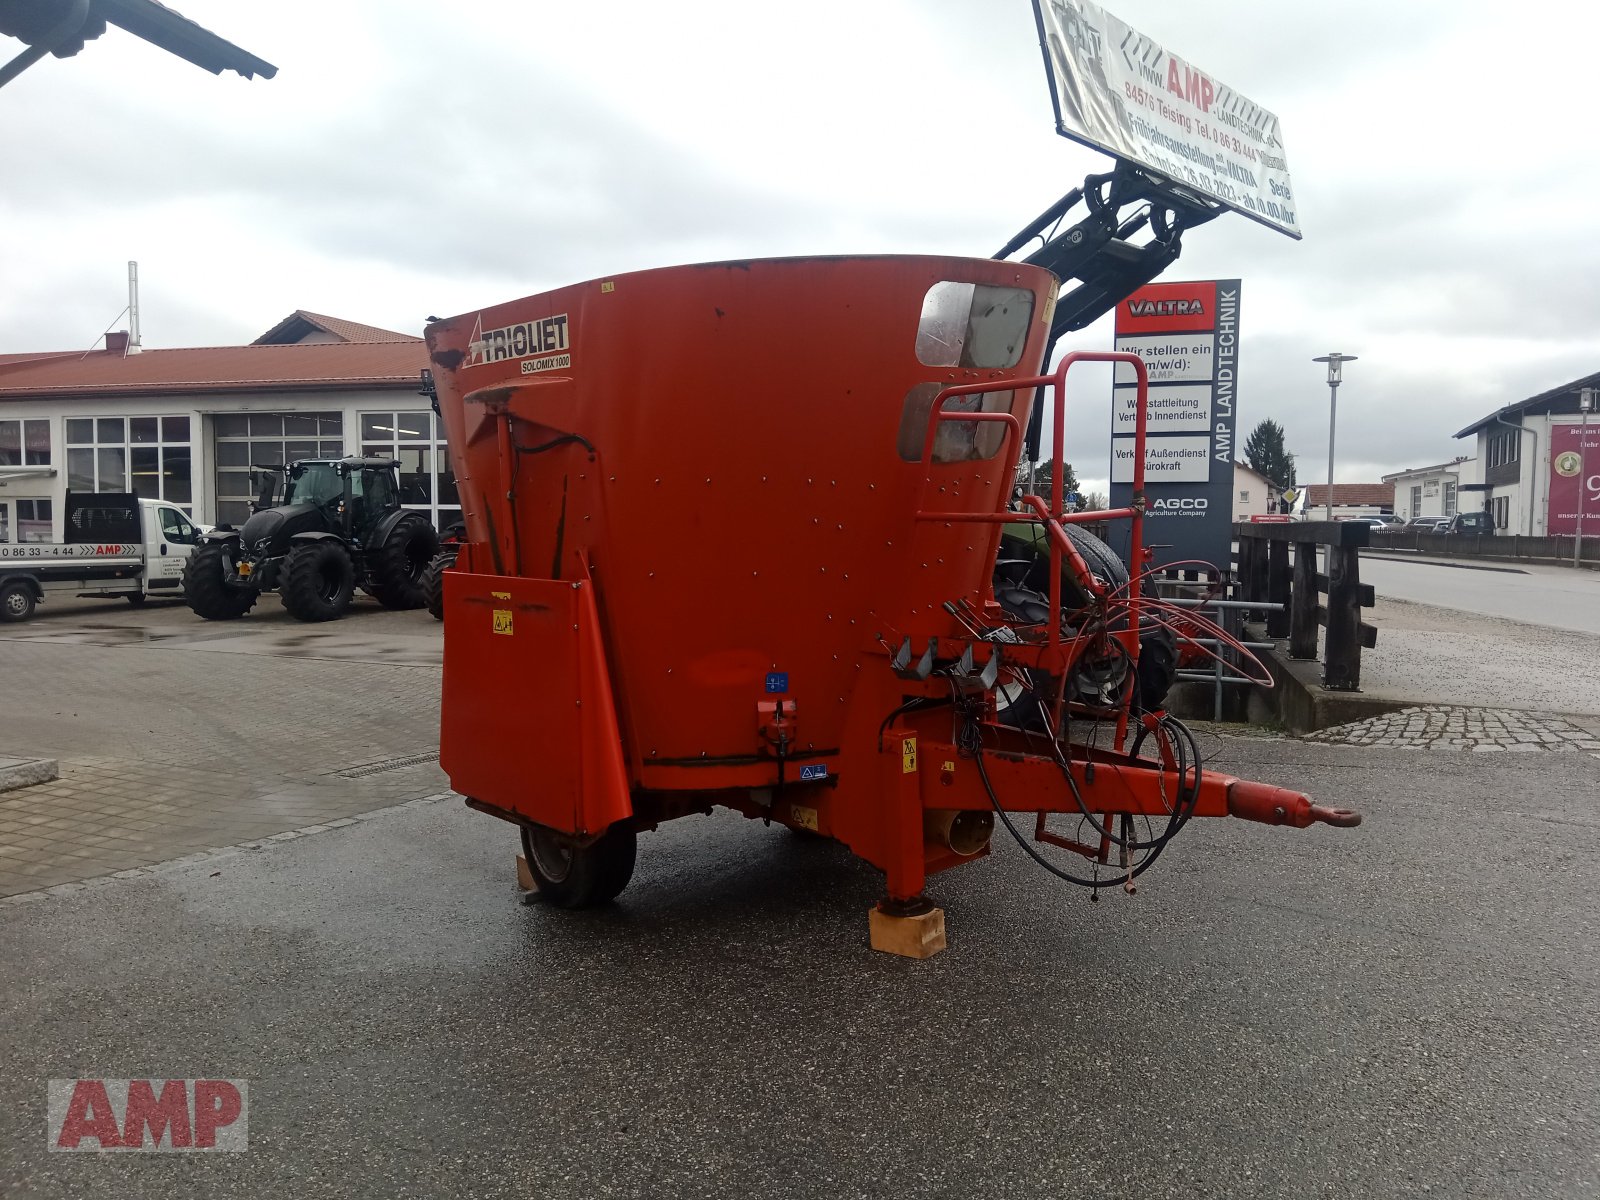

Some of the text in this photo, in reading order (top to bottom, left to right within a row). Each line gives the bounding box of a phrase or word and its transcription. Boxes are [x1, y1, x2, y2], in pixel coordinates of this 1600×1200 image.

[1125, 81, 1155, 112] 84576
[1157, 98, 1192, 134] Teising
[1195, 118, 1212, 140] Tel.
[1226, 159, 1258, 188] VALTRA
[1268, 177, 1292, 201] Serie
[1243, 192, 1256, 210] ab
[1127, 299, 1205, 317] VALTRA
[481, 315, 567, 362] TRIOLIET
[1146, 345, 1188, 356] stellen
[1192, 344, 1211, 354] ein
[522, 355, 569, 373] SOLOMIX 1000
[1143, 359, 1191, 371] m/w/d):
[1149, 370, 1174, 379] AMP
[1215, 289, 1237, 463] AMP LANDTECHNIK
[1119, 410, 1207, 421] Vertb Innendienst
[1115, 448, 1206, 459] Verkf Außendienst
[1144, 461, 1181, 471] ürokraft
[1153, 498, 1208, 509] AGCO
[1145, 510, 1206, 518] Agriculture Company
[2, 548, 9, 557] 0
[12, 547, 25, 556] 86
[28, 547, 41, 556] 33
[52, 547, 59, 556] 4
[62, 547, 74, 556] 44
[95, 544, 121, 555] AMP
